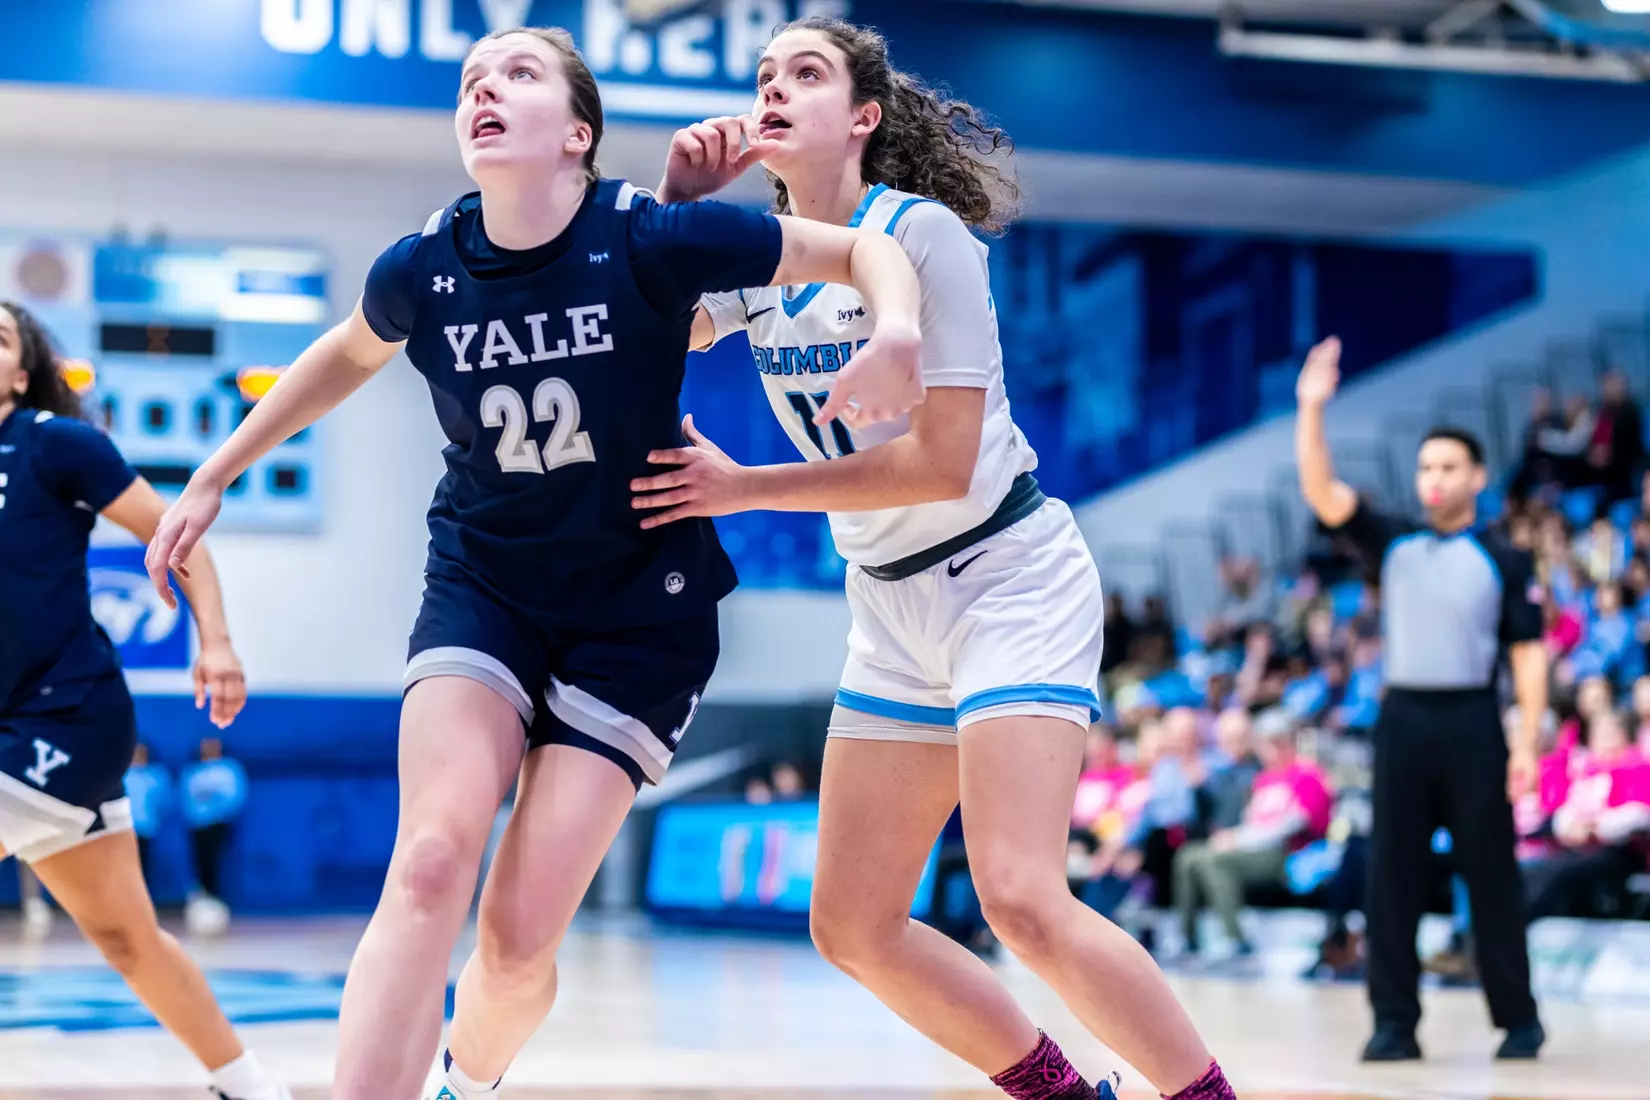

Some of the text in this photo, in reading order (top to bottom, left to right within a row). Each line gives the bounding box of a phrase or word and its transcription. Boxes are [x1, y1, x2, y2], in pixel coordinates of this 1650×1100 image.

[589, 252, 603, 264] Ivy
[837, 309, 854, 322] Ivy
[444, 303, 614, 372] YALE
[751, 338, 871, 376] OLUMBI
[480, 376, 597, 475] 22
[25, 738, 71, 787] Y
